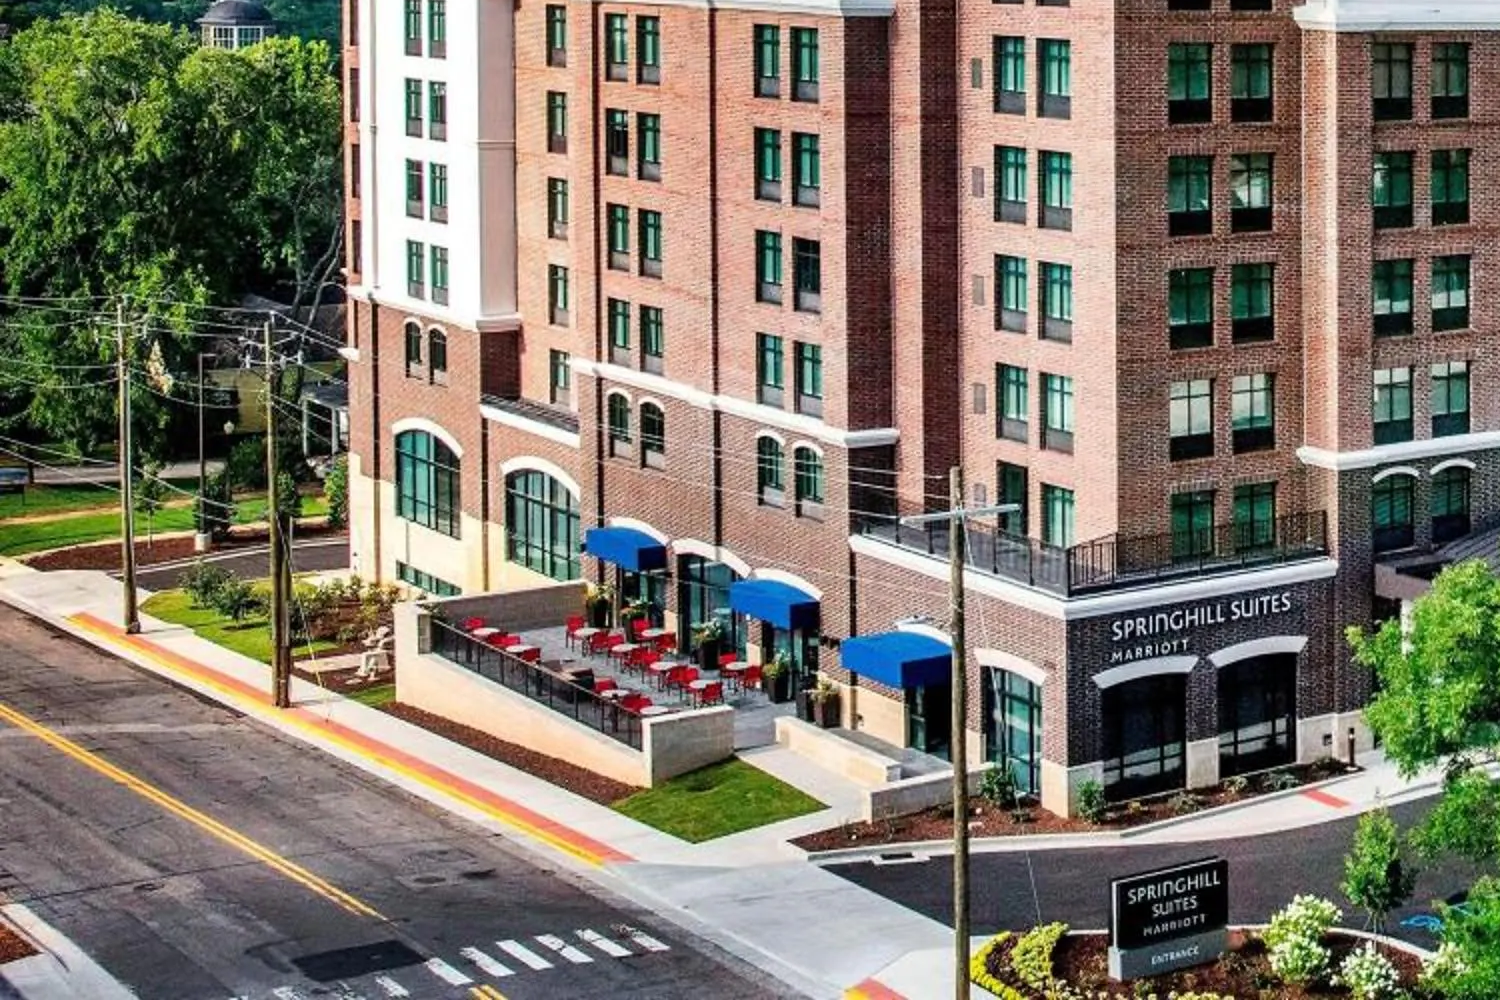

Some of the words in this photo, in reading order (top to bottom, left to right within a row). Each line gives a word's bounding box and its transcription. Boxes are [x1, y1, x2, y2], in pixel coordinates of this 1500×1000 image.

[1111, 604, 1225, 641] SPRINGHILL
[1231, 592, 1291, 620] SUITES
[1110, 639, 1189, 662] MARRIOTT
[1128, 870, 1221, 904] SPRINGHILL
[1152, 896, 1197, 917] SUITES
[1143, 914, 1205, 936] MARRIOTT
[1151, 946, 1199, 965] ENTRANCE
